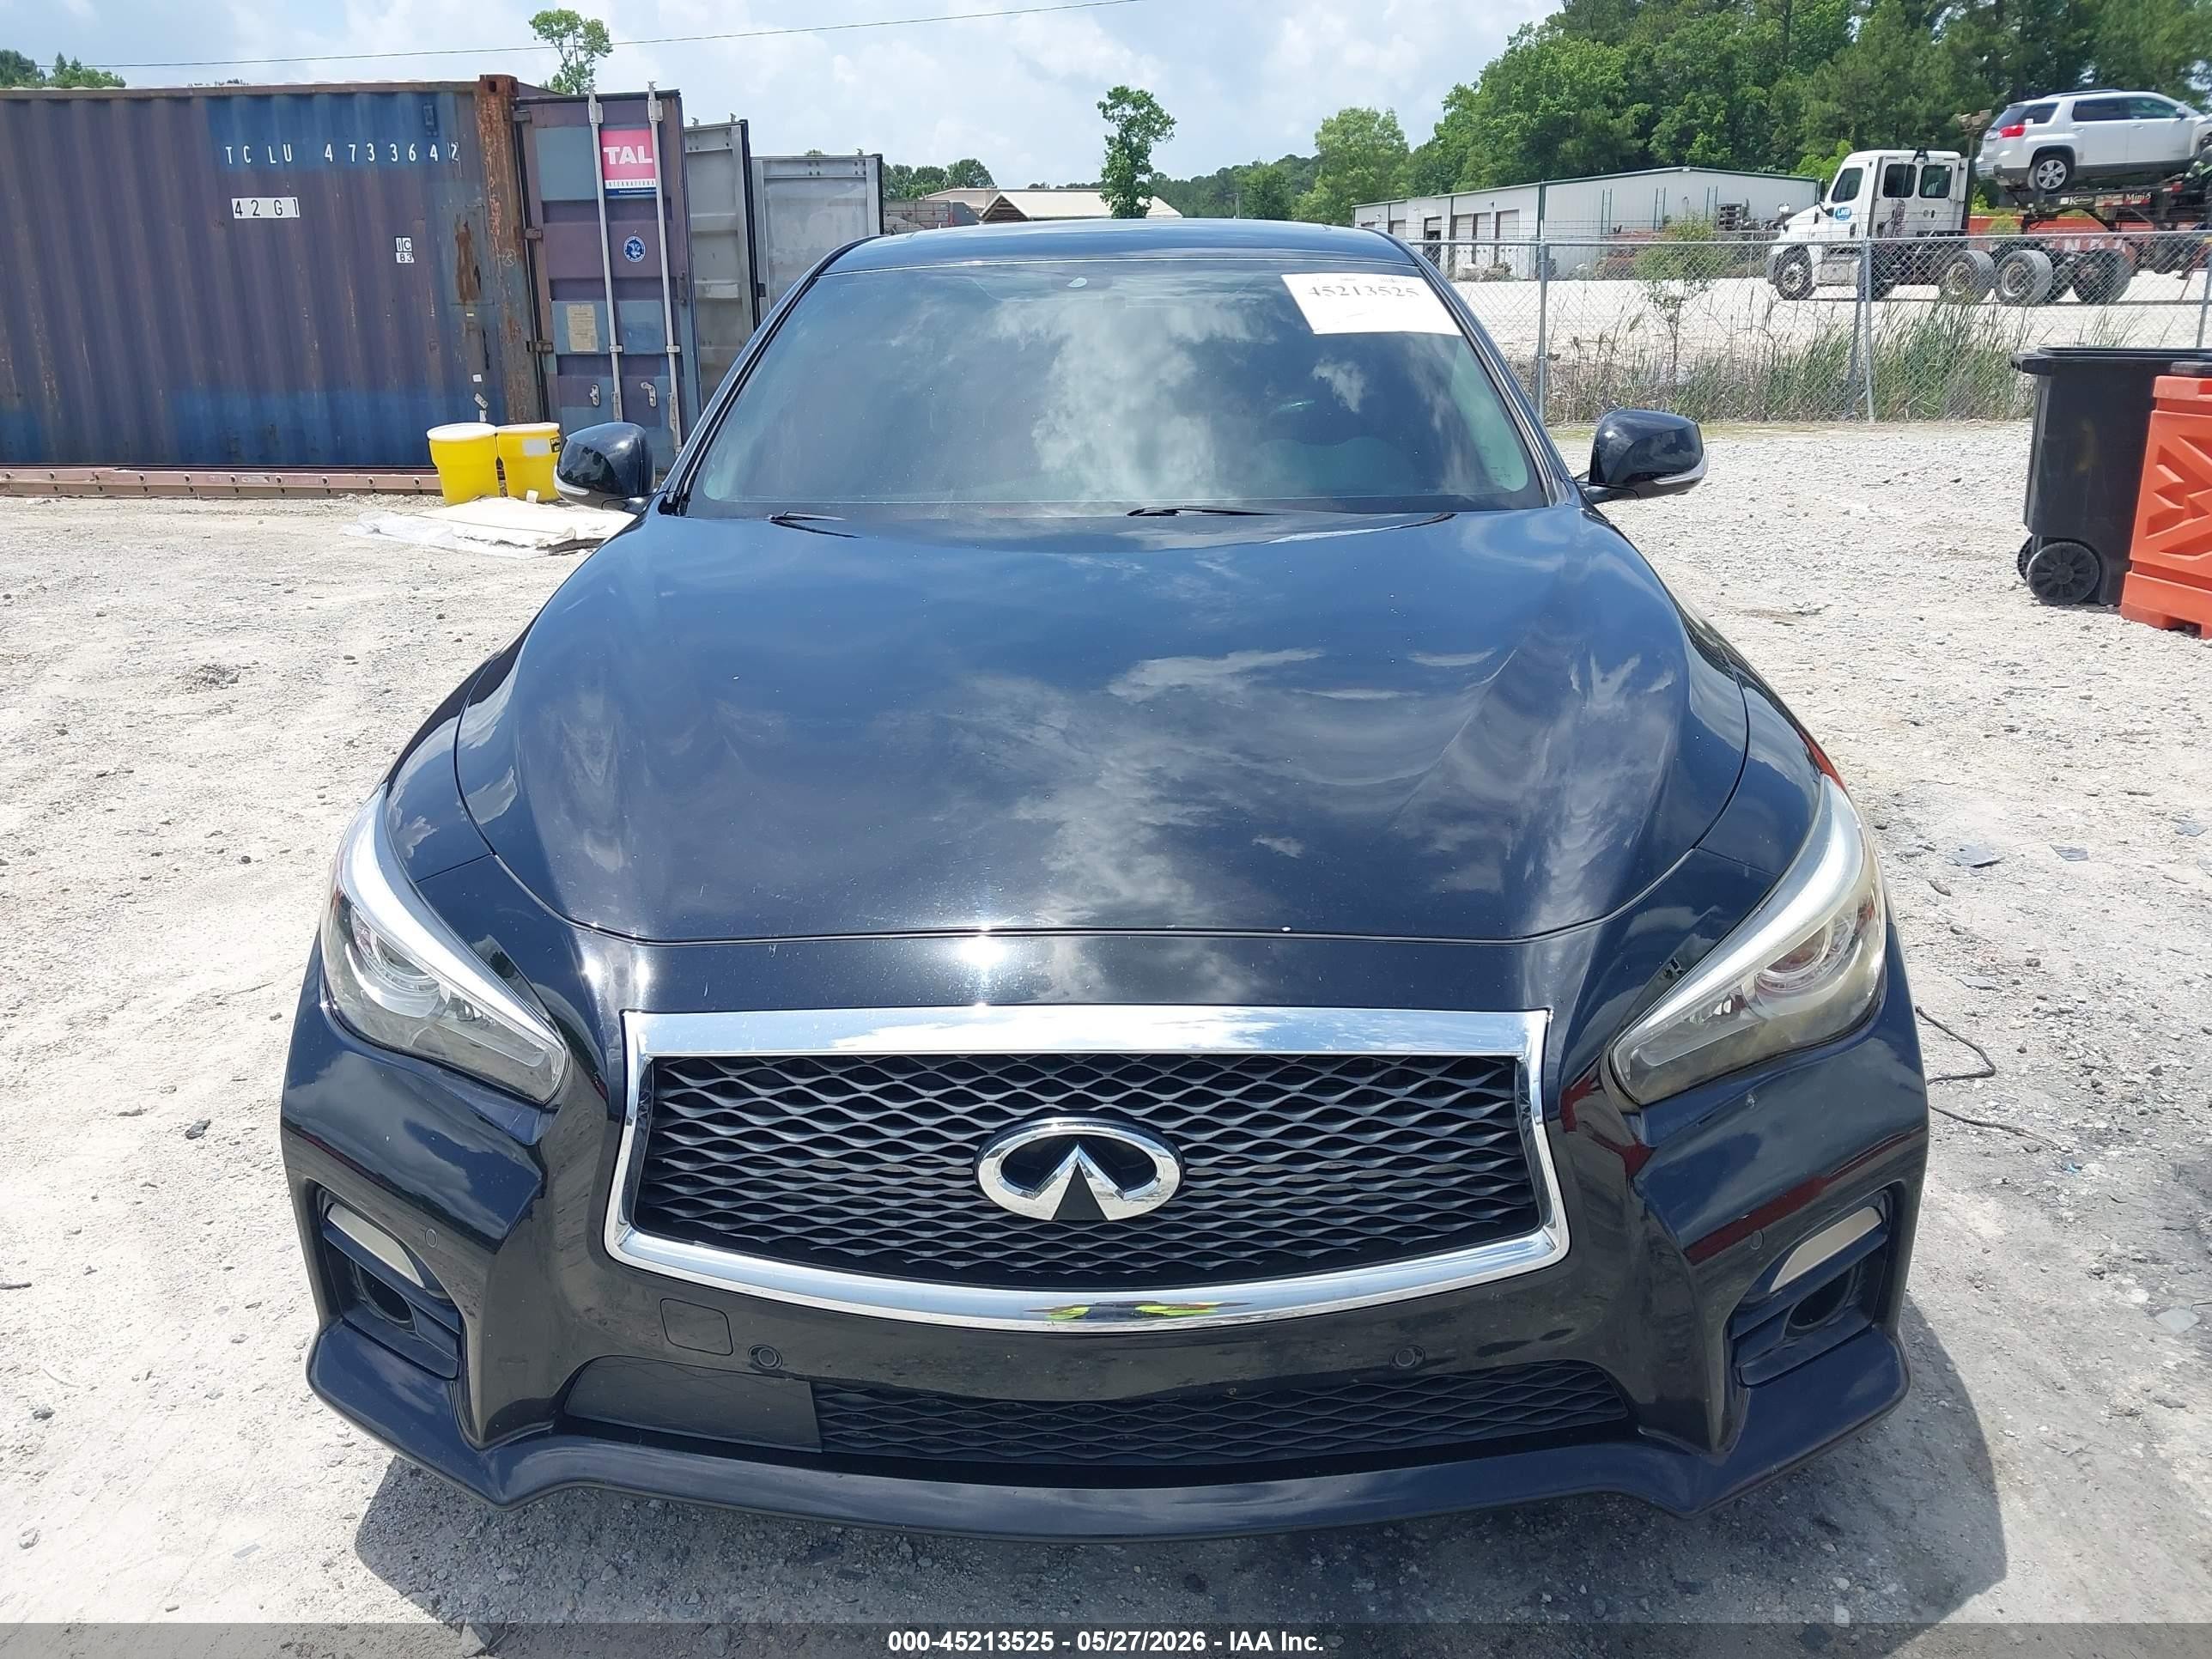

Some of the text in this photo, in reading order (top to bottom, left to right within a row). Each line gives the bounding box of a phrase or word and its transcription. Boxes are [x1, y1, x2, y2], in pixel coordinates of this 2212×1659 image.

[603, 145, 653, 165] TAL
[399, 253, 412, 262] 83
[1309, 286, 1419, 297] 45213525
